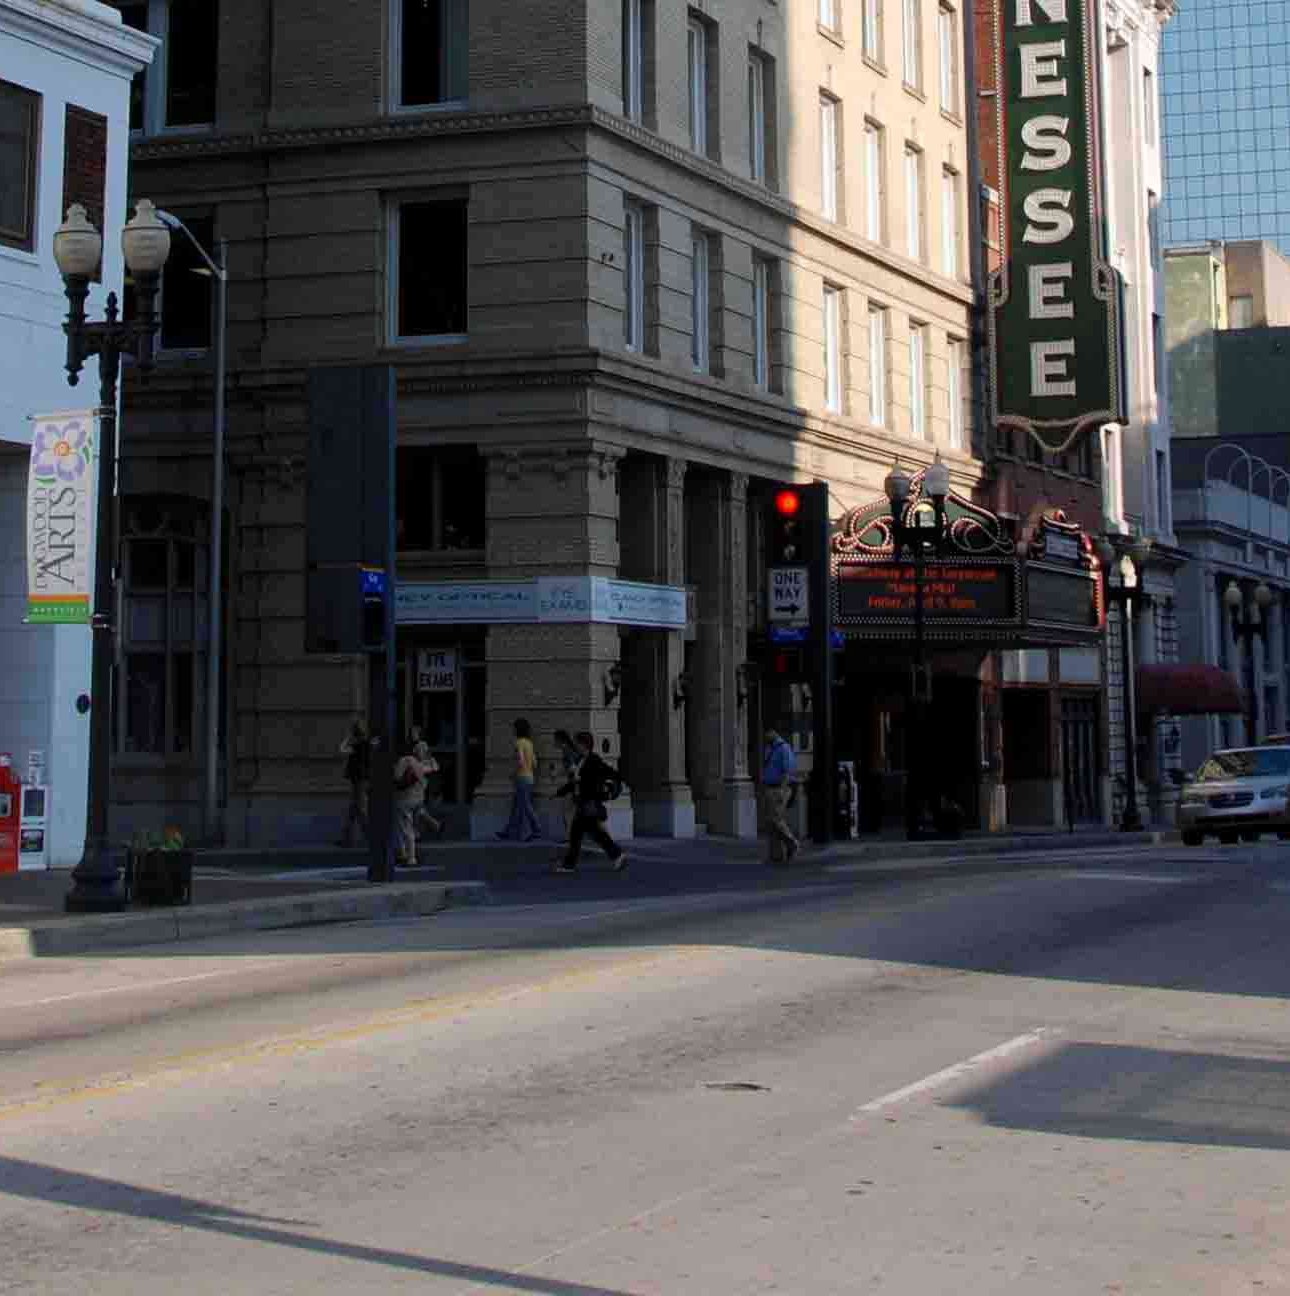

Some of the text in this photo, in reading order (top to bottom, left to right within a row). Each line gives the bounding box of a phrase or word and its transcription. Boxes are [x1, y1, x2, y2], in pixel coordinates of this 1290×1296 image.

[43, 487, 76, 584] ARTS
[775, 572, 801, 585] ONE
[774, 587, 802, 601] WAY
